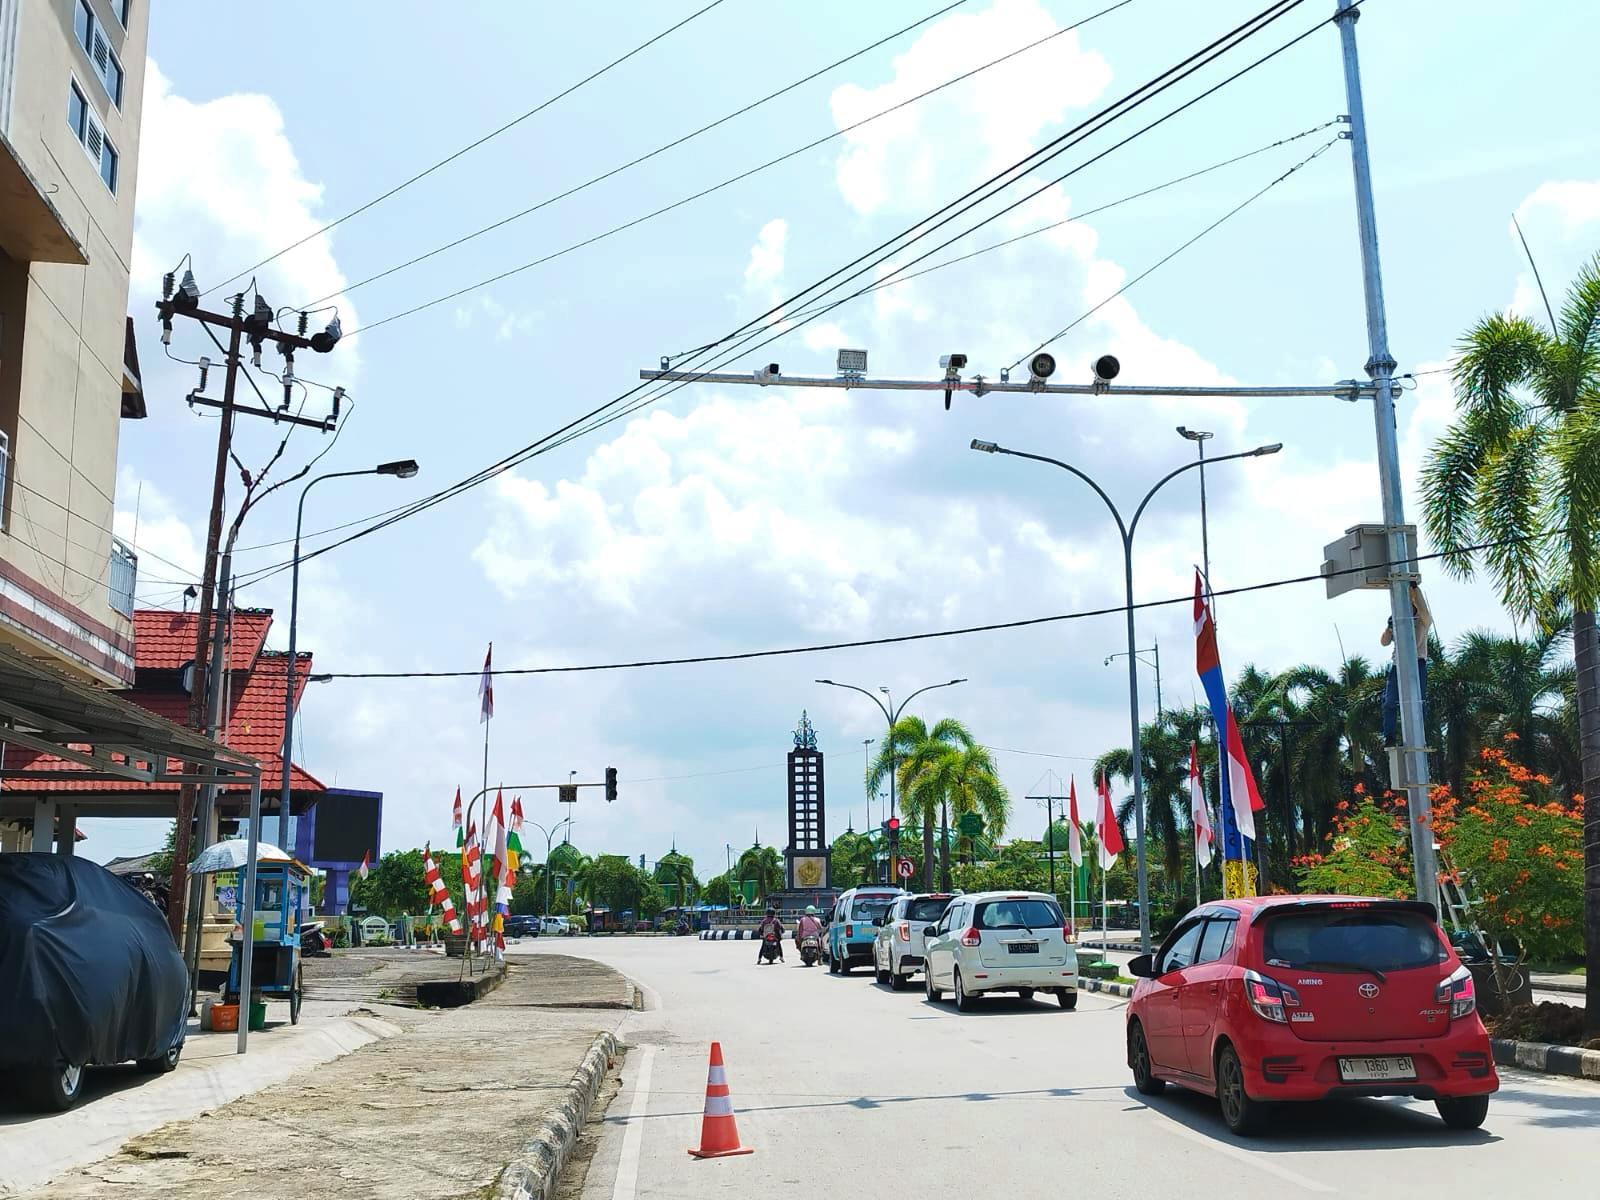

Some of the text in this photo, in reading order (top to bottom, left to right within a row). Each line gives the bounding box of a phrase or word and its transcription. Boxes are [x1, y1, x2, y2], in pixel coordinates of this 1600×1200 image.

[1340, 1058, 1413, 1073] KT 1360 EN
